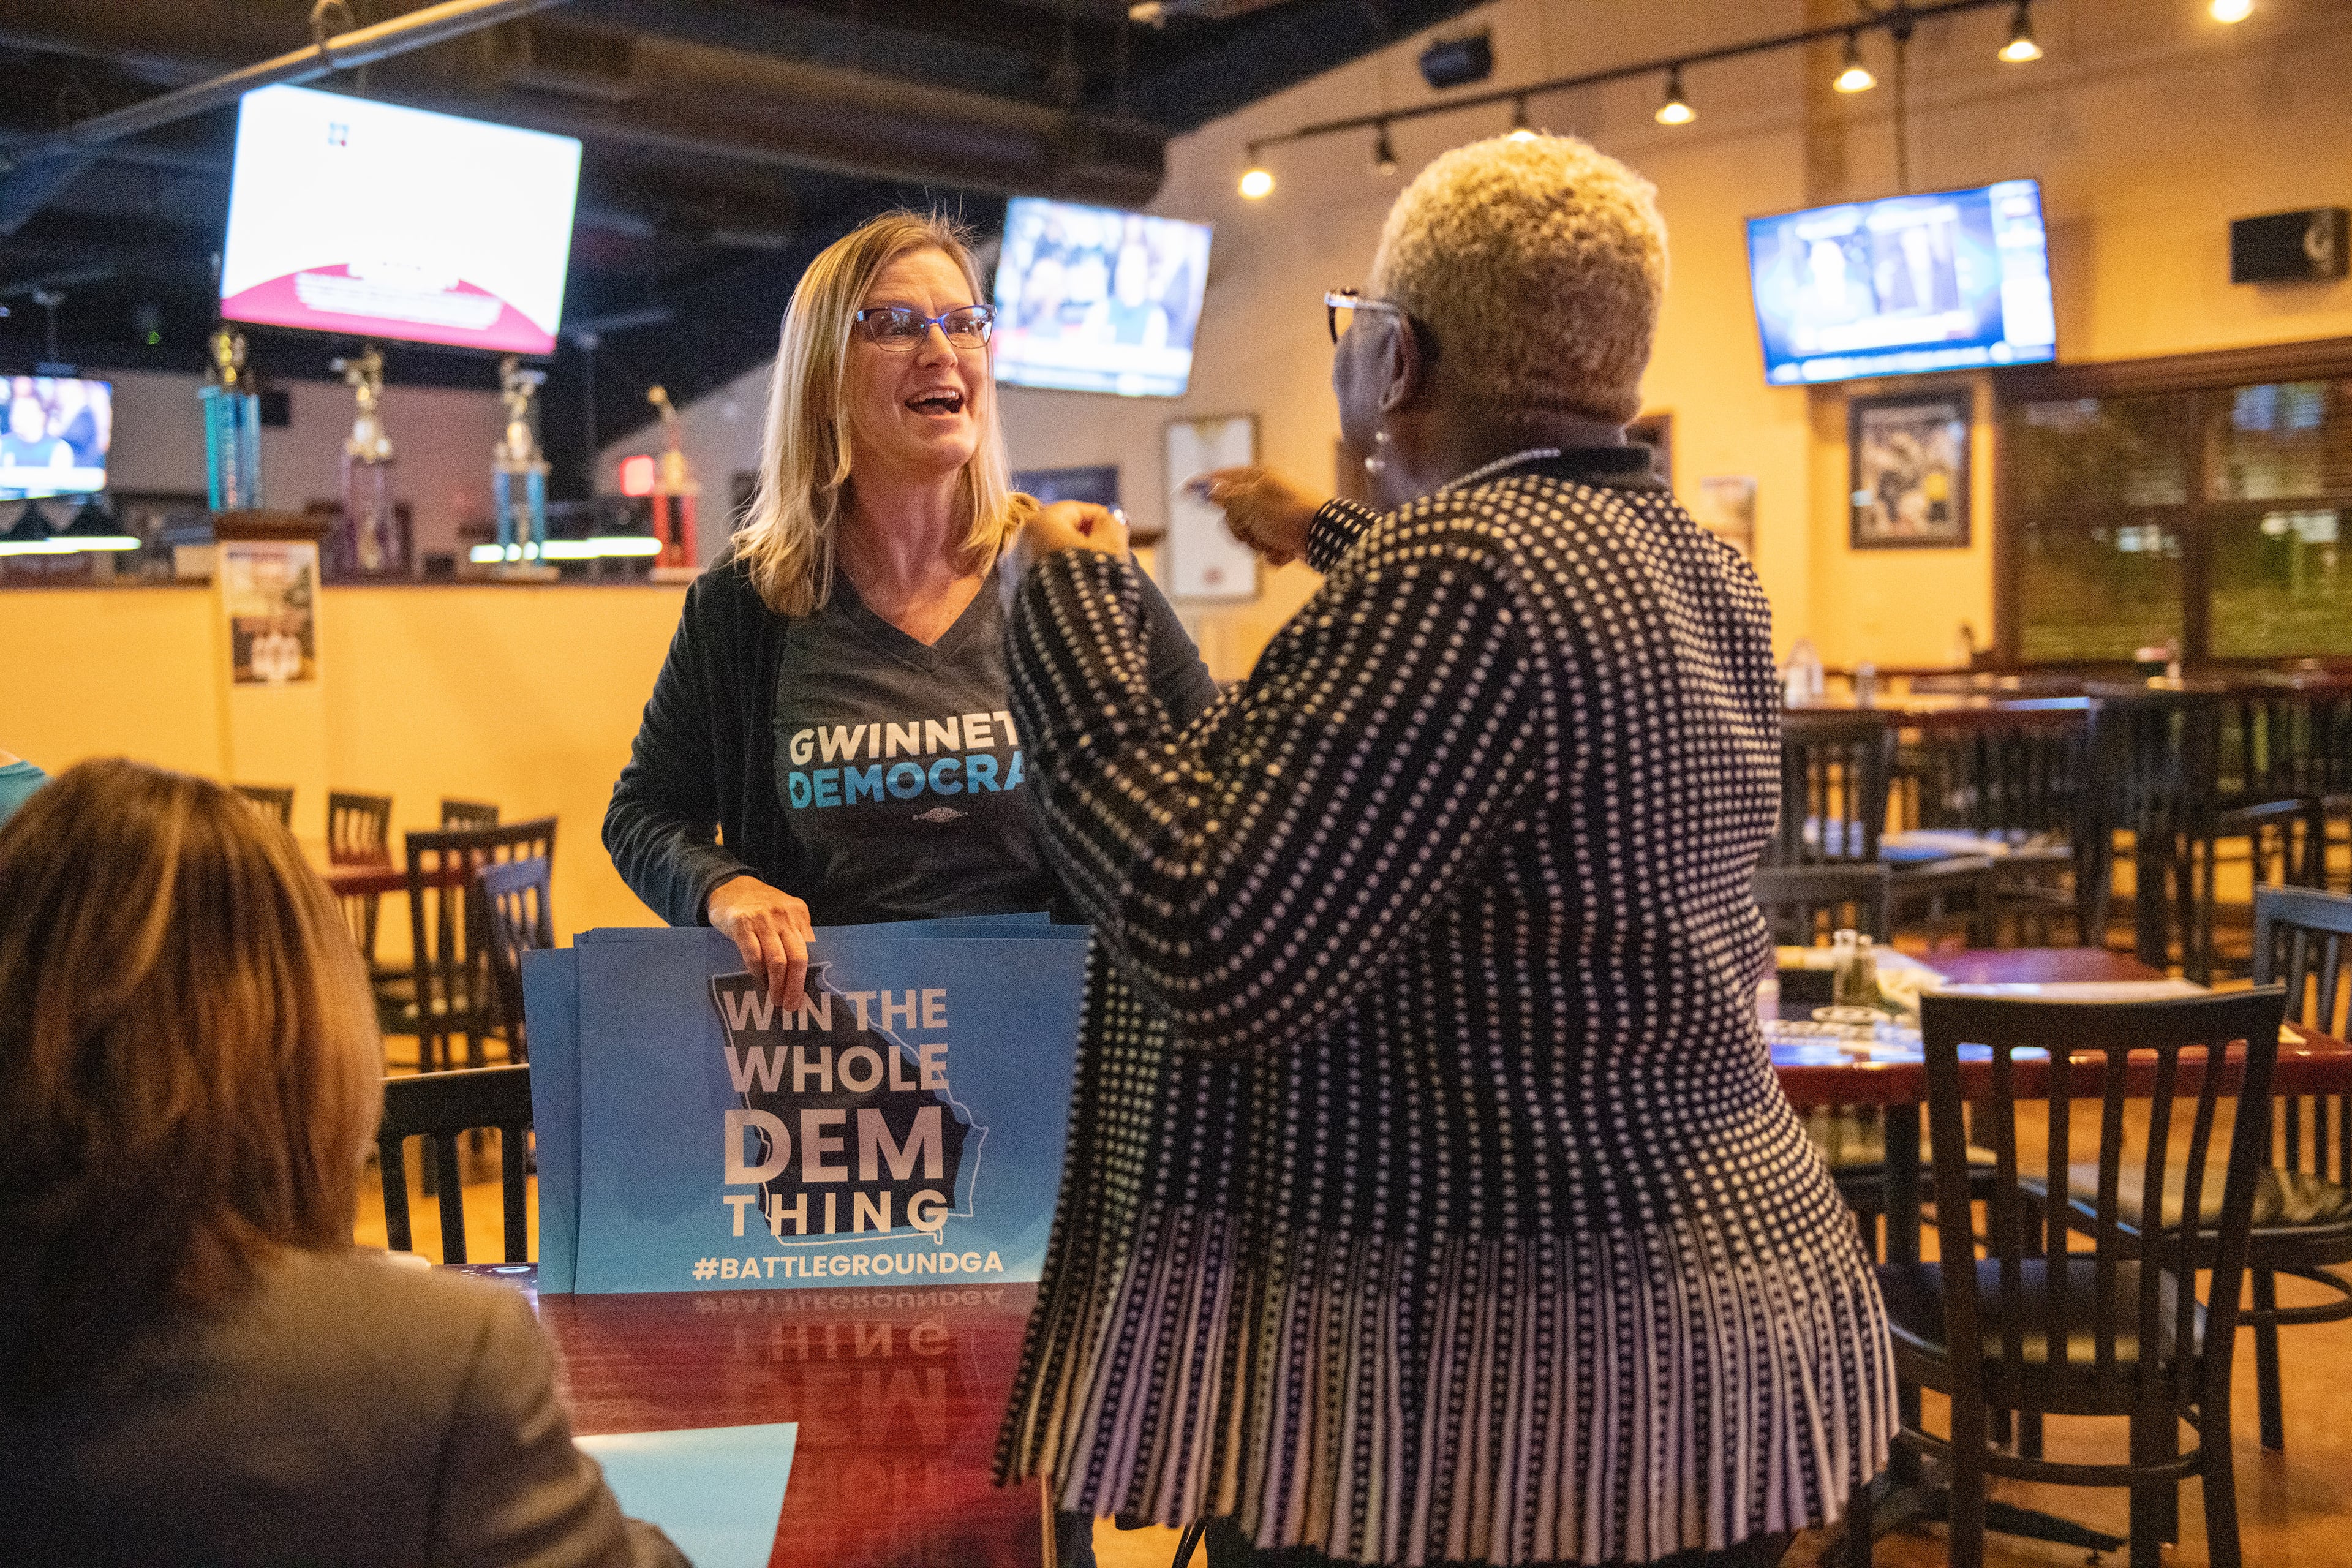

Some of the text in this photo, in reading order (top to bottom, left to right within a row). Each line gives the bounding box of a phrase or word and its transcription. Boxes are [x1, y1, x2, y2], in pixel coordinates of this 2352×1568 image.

[789, 710, 1018, 766] GWINNET
[722, 988, 948, 1031] WIN THE
[724, 1043, 949, 1093] WHOLE
[724, 1106, 944, 1185] DEM
[723, 1189, 948, 1237] THING
[692, 1251, 1004, 1281] #BATTLEGROUNDGA
